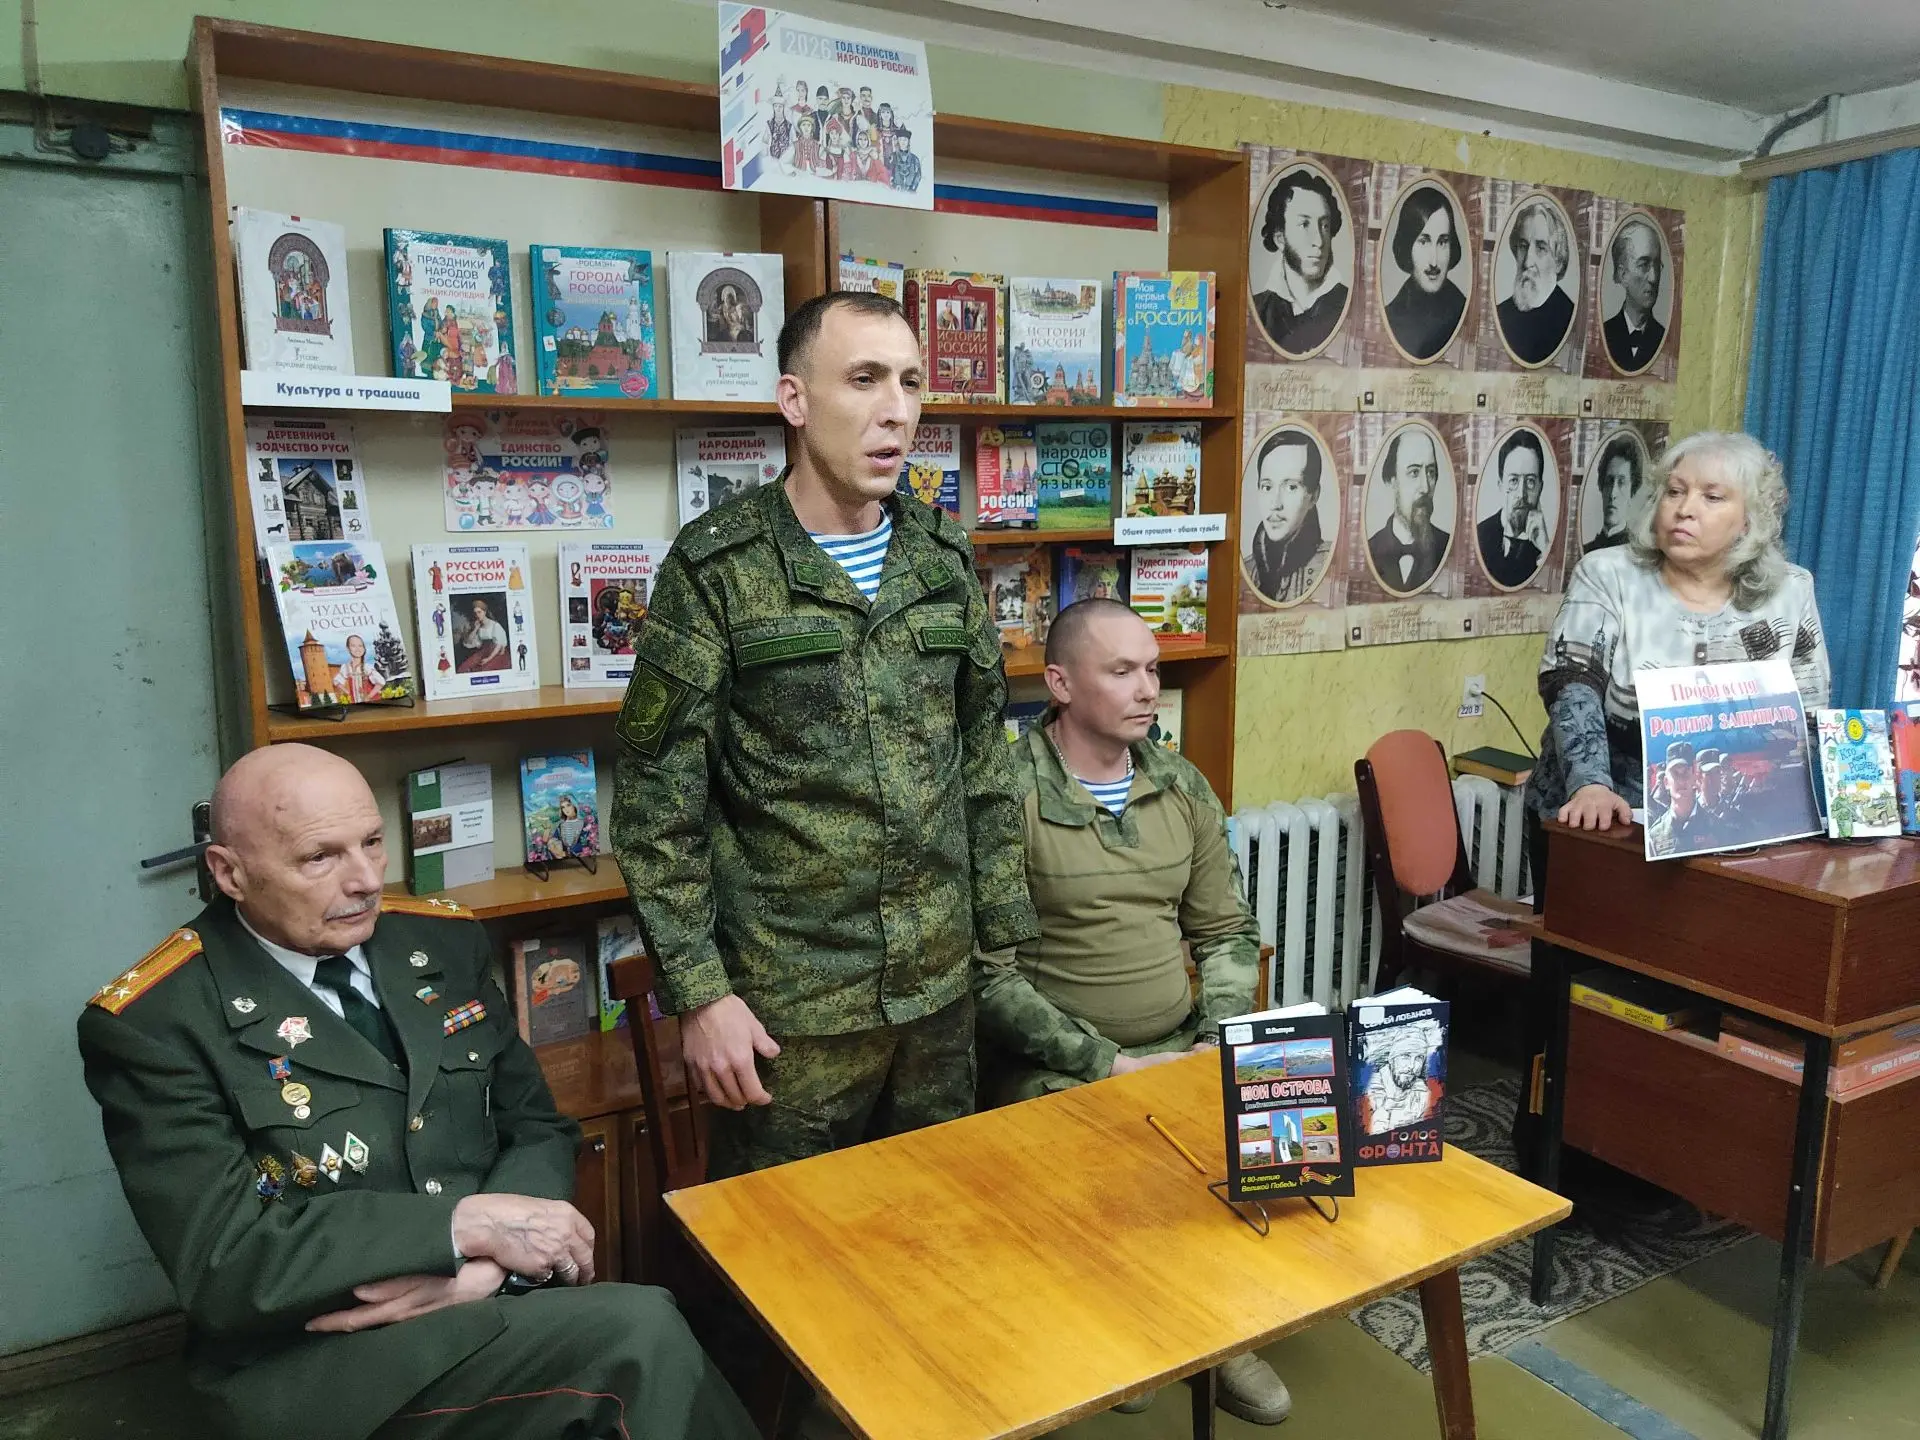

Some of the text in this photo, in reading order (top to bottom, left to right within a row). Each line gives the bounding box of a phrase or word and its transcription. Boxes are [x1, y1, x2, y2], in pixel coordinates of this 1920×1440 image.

[785, 31, 831, 59] 2026
[835, 40, 900, 61] ГОД ЕДИНСТВА
[837, 52, 915, 75] НАРОДОВ РОССИИ
[417, 254, 485, 270] ПРАЗДНИКИ
[425, 266, 479, 280] НАРОДОВ
[570, 270, 623, 284] ГОРОДА
[429, 277, 476, 290] РОССИИ
[569, 283, 624, 295] РОССИИ
[1135, 283, 1154, 293] Моя
[423, 288, 485, 300] ЭНЦИКЛОПЕДИЯ
[1135, 293, 1166, 302] первая
[1135, 301, 1158, 311] книга
[1135, 311, 1203, 328] РОССИИ
[937, 331, 988, 343] ИСТОРИЯ
[1027, 326, 1086, 338] ИСТОРИЯ
[937, 341, 988, 355] РОССИИ
[1031, 338, 1083, 349] РОССИИ
[277, 382, 421, 401] Культура и традиции
[266, 430, 336, 441] ДЕРЕВЯННОЕ
[1069, 428, 1108, 448] СТО
[255, 442, 350, 453] ЗОДЧЕСТВО РУСИ
[501, 443, 562, 453] ЕДИНСТВО
[699, 438, 766, 449] НАРОДНЫЙ
[699, 451, 767, 461] КАЛЕНДАРЬ
[1041, 447, 1107, 461] народов
[502, 456, 563, 468] РОССИИ!
[1041, 458, 1080, 479] СТО
[1040, 478, 1106, 490] языков
[980, 494, 1036, 509] РОССИЯ,
[446, 558, 505, 571] РУССКИЙ
[585, 554, 650, 564] НАРОДНЫЕ
[1136, 557, 1206, 569] Чудеса природы
[584, 566, 653, 575] ПРОМЫСЛЫ
[1136, 568, 1178, 580] России
[447, 572, 506, 583] КОСТЮМ
[310, 602, 370, 617] ЧУДЕСА
[310, 615, 375, 630] РОССИИ
[1460, 704, 1473, 715] 220
[1395, 1008, 1433, 1022] ЛОБАНОВ
[1240, 1079, 1333, 1102] МОИ ОСТРОВА
[1391, 1129, 1438, 1141] ГОЛОС
[1359, 1141, 1439, 1159] ФРОНТА
[1240, 1174, 1280, 1184] К 80-летию
[1241, 1180, 1297, 1192] Великой Победы
